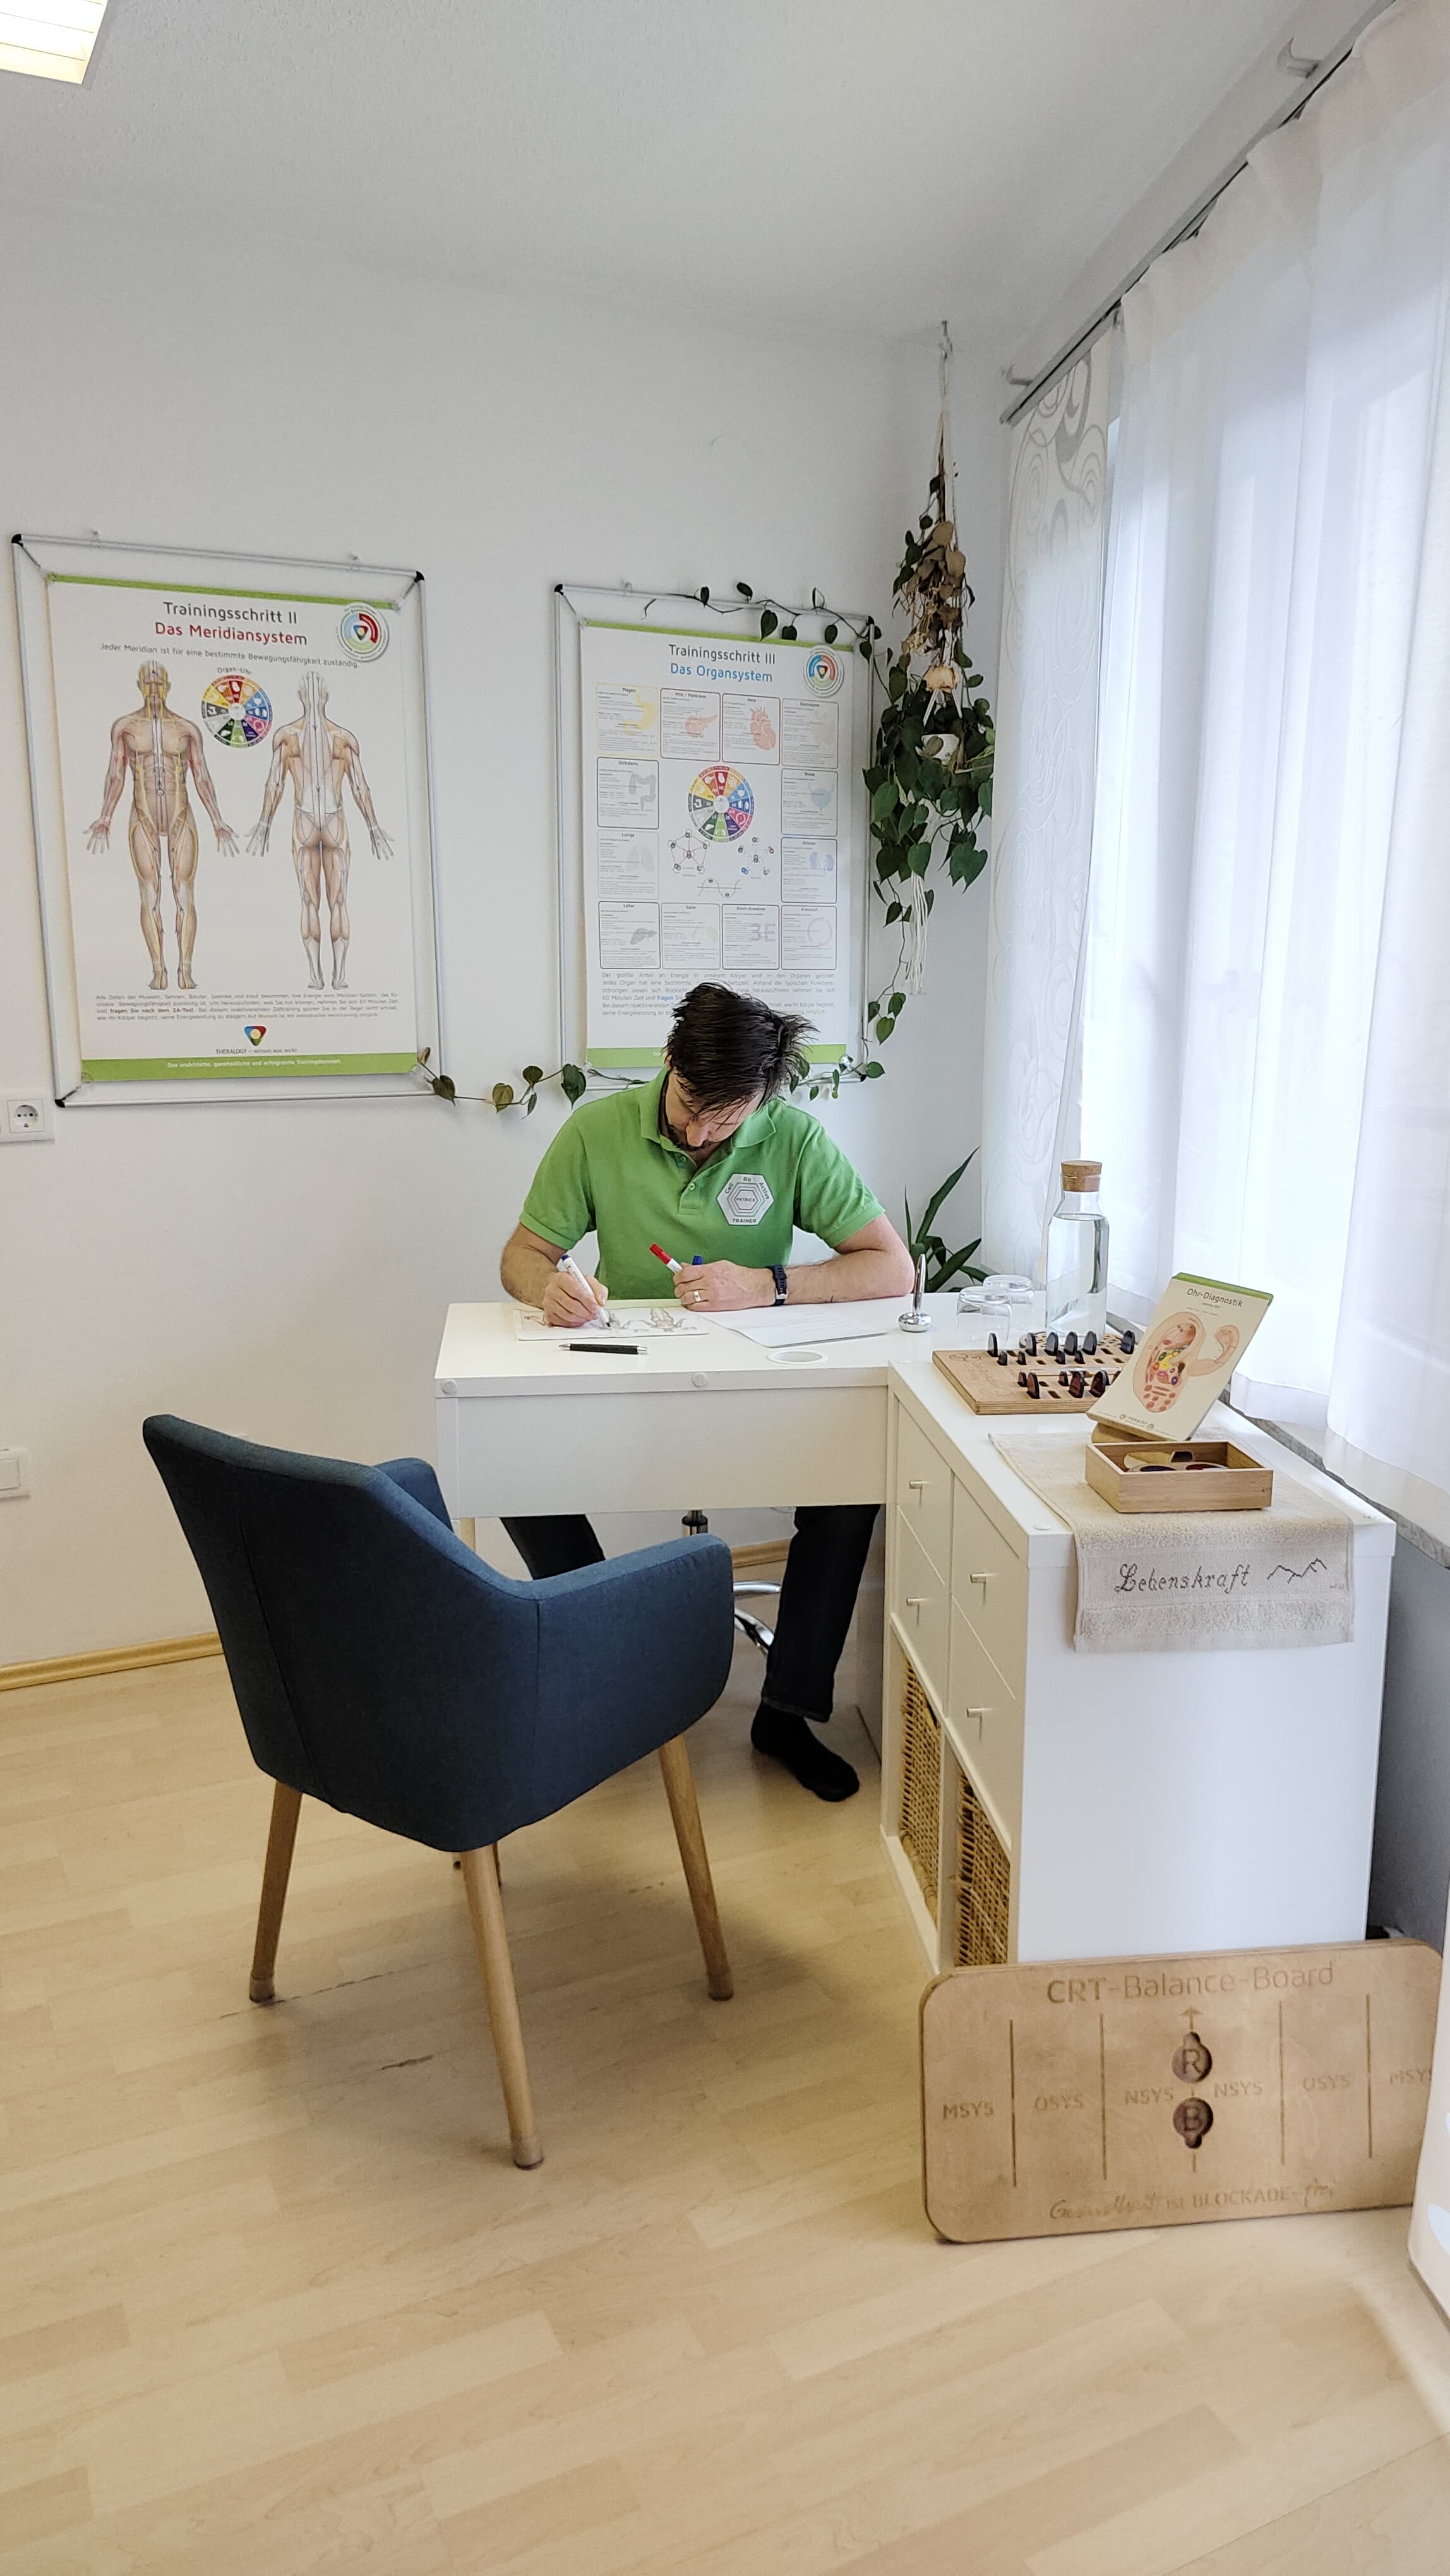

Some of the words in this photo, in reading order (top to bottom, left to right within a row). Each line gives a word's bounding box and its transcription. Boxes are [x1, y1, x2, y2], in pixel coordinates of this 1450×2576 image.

[163, 602, 282, 623] Trainingsschritt
[155, 621, 183, 636] Das
[189, 624, 308, 645] Meridiansystem
[124, 644, 157, 653] Meridian
[172, 648, 183, 656] für
[205, 650, 246, 660] bestimmte
[249, 653, 321, 665] Bewegungsfähigkeit
[668, 644, 760, 664] Trainingsschritt
[765, 652, 776, 665] III
[670, 662, 692, 675] Das
[697, 665, 772, 683] Organsystem
[724, 1183, 734, 1194] Cell
[758, 1182, 770, 1200] Active
[1187, 1288, 1243, 1308] Ohr-Diagnostik
[1114, 1563, 1250, 1594] Lebenskraft
[1046, 1959, 1334, 2005] CRT-Balance-Board
[1182, 2049, 1202, 2074] R
[1213, 2080, 1263, 2098] NSYS
[1302, 2074, 1352, 2092] OSYS
[1034, 2093, 1084, 2111] OSYS
[1125, 2086, 1173, 2105] NSYS
[942, 2101, 995, 2120] MSYS
[1183, 2105, 1204, 2132] B
